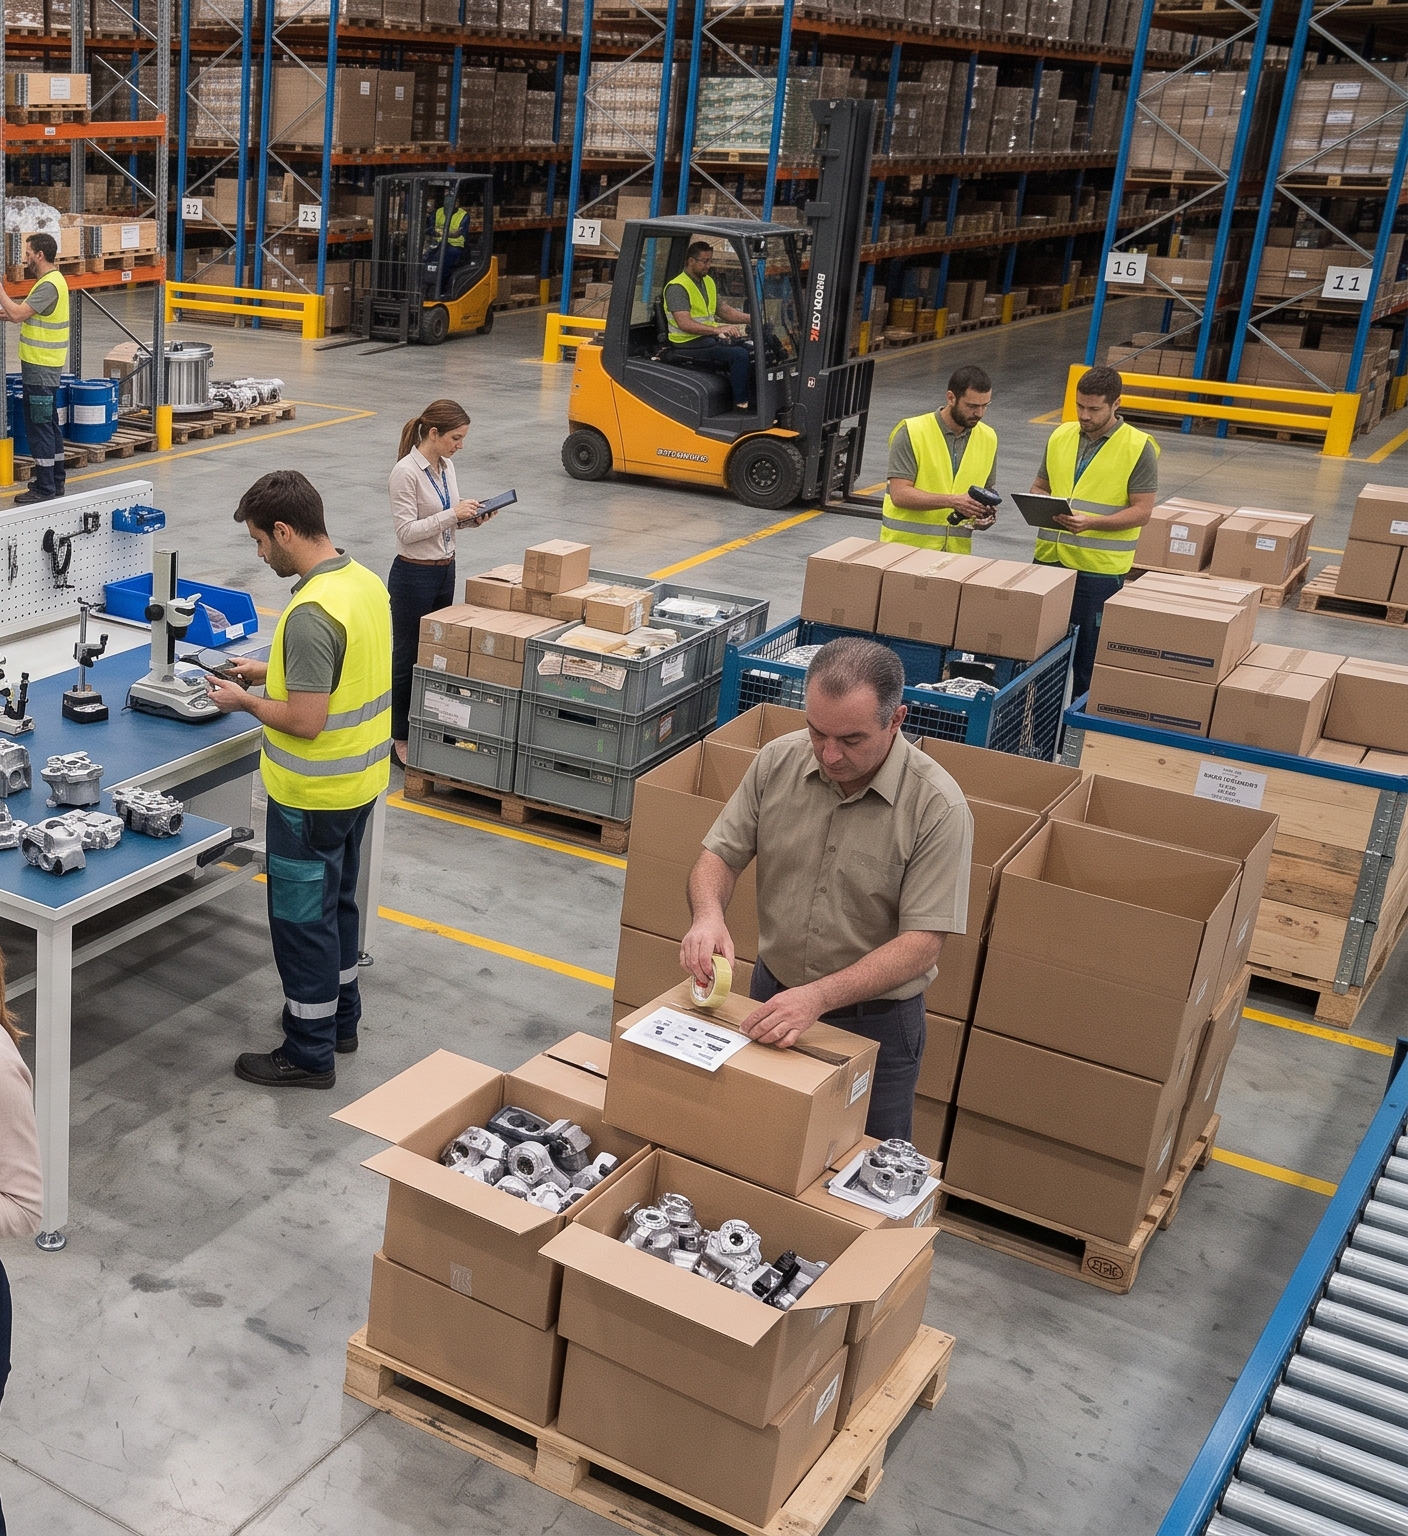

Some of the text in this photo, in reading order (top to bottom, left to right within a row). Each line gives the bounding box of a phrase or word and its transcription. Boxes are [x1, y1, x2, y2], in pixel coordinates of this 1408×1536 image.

[302, 210, 317, 223] 23
[578, 225, 596, 238] 27
[1112, 260, 1137, 277] 16
[1332, 274, 1360, 292] 11
